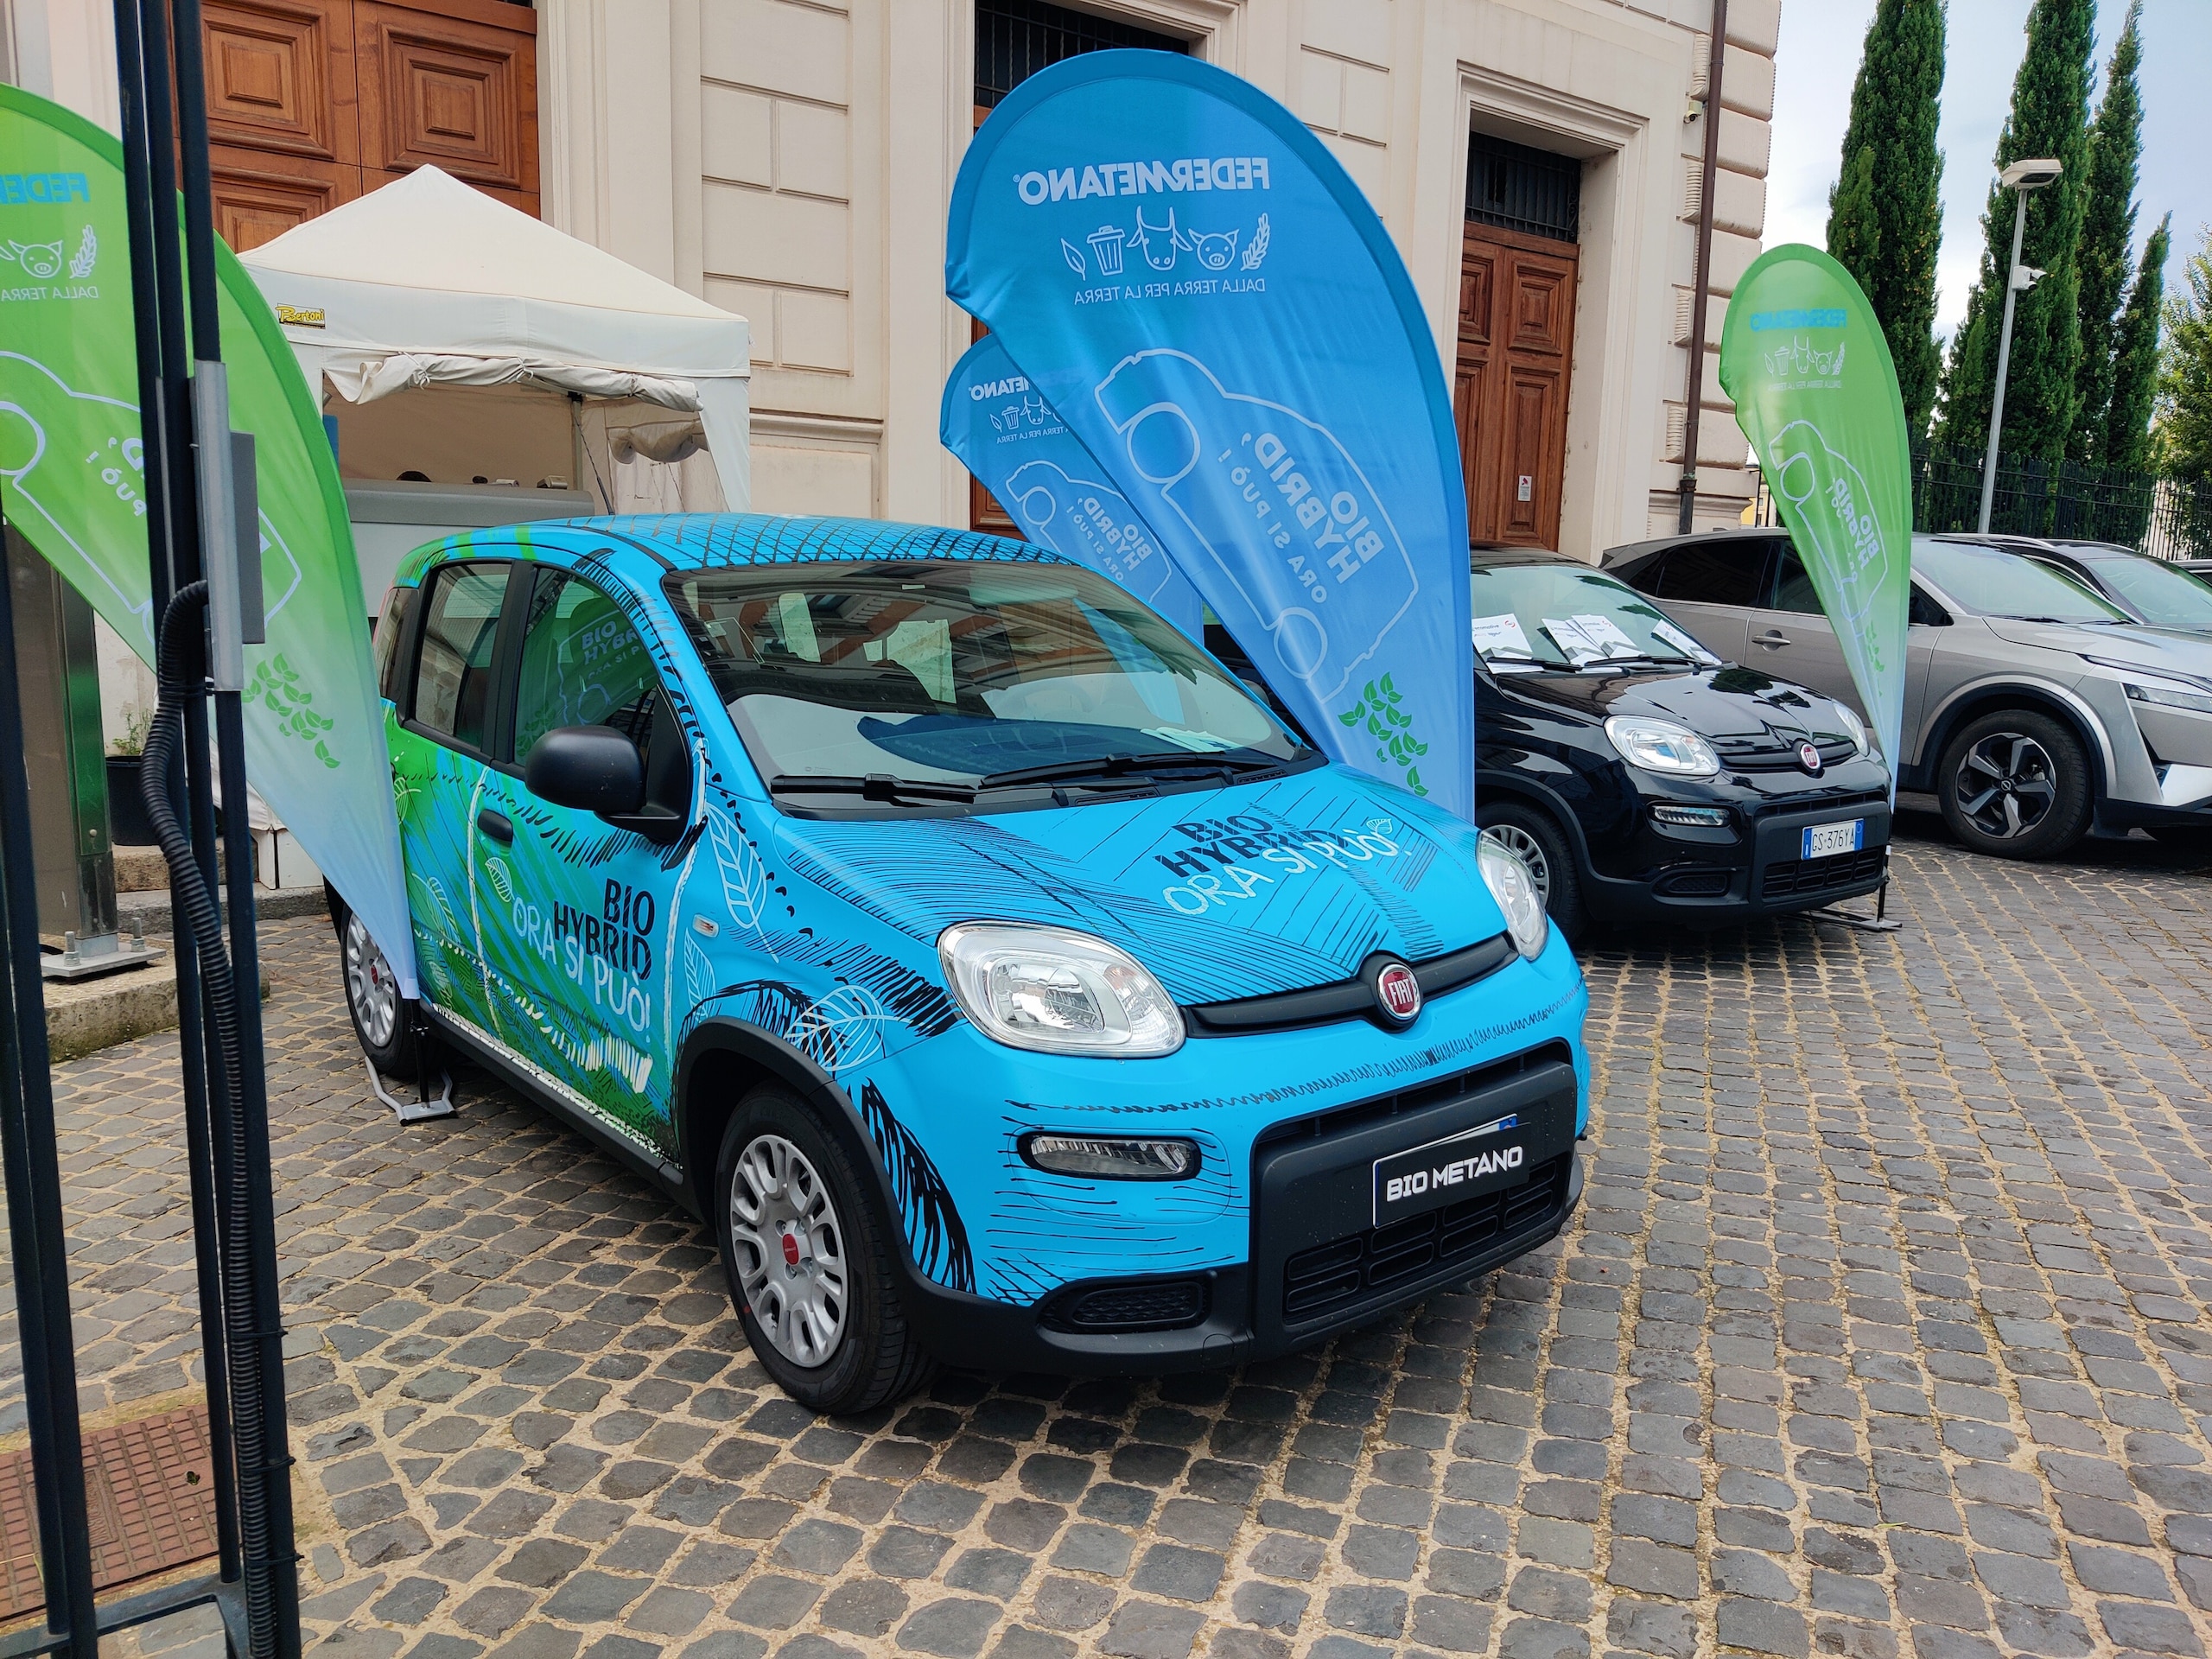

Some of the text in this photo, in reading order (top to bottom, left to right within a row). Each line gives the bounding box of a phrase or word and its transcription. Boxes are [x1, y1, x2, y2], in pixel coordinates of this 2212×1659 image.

[275, 306, 324, 322] Bertoni
[1170, 815, 1274, 843] BIO
[603, 878, 655, 936] BIO
[1162, 865, 1274, 915] ORA
[1262, 846, 1319, 874] SI
[512, 897, 557, 965] ORA
[564, 935, 585, 985] SI
[553, 900, 652, 981] HYBRID
[1387, 978, 1414, 1007] FIAT
[1387, 1146, 1523, 1202] BIO METANO
